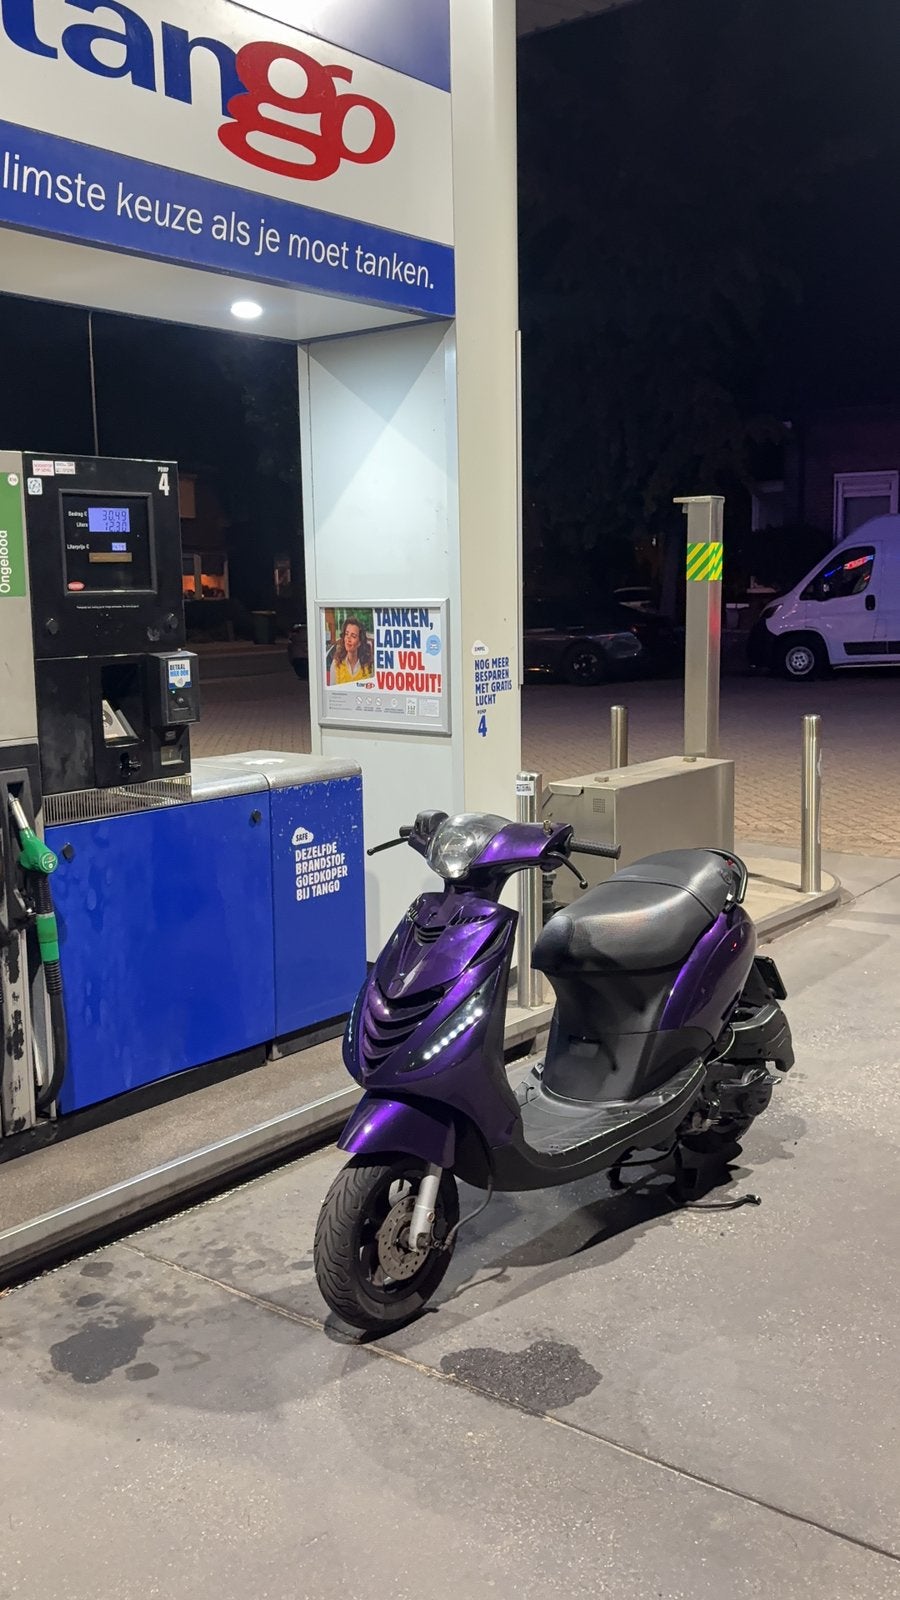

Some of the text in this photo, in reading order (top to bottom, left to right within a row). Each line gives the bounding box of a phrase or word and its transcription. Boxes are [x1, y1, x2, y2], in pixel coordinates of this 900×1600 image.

[1, 0, 396, 181] tango
[116, 182, 204, 234] keuze
[212, 210, 251, 246] als
[254, 220, 281, 257] je
[288, 232, 349, 270] moet
[355, 244, 435, 289] tanken.
[159, 473, 170, 496] 4
[102, 510, 127, 522] 30.49
[374, 608, 434, 630] TANKEN,
[376, 629, 421, 649] LADEN
[376, 650, 425, 671] EN VOL
[474, 656, 510, 671] NOG MEER
[376, 671, 442, 693] VOORUIT!
[474, 669, 510, 683] BESPAREN
[475, 680, 512, 695] MET GRATIS
[475, 694, 496, 706] LUCHT
[478, 714, 488, 737] 4
[296, 833, 308, 842] SAFE
[295, 842, 338, 862] DEZELFDE
[295, 853, 346, 875] BRANDSTOF
[296, 865, 348, 888] GOEDKOPER
[296, 880, 341, 902] BIJ TANGO
